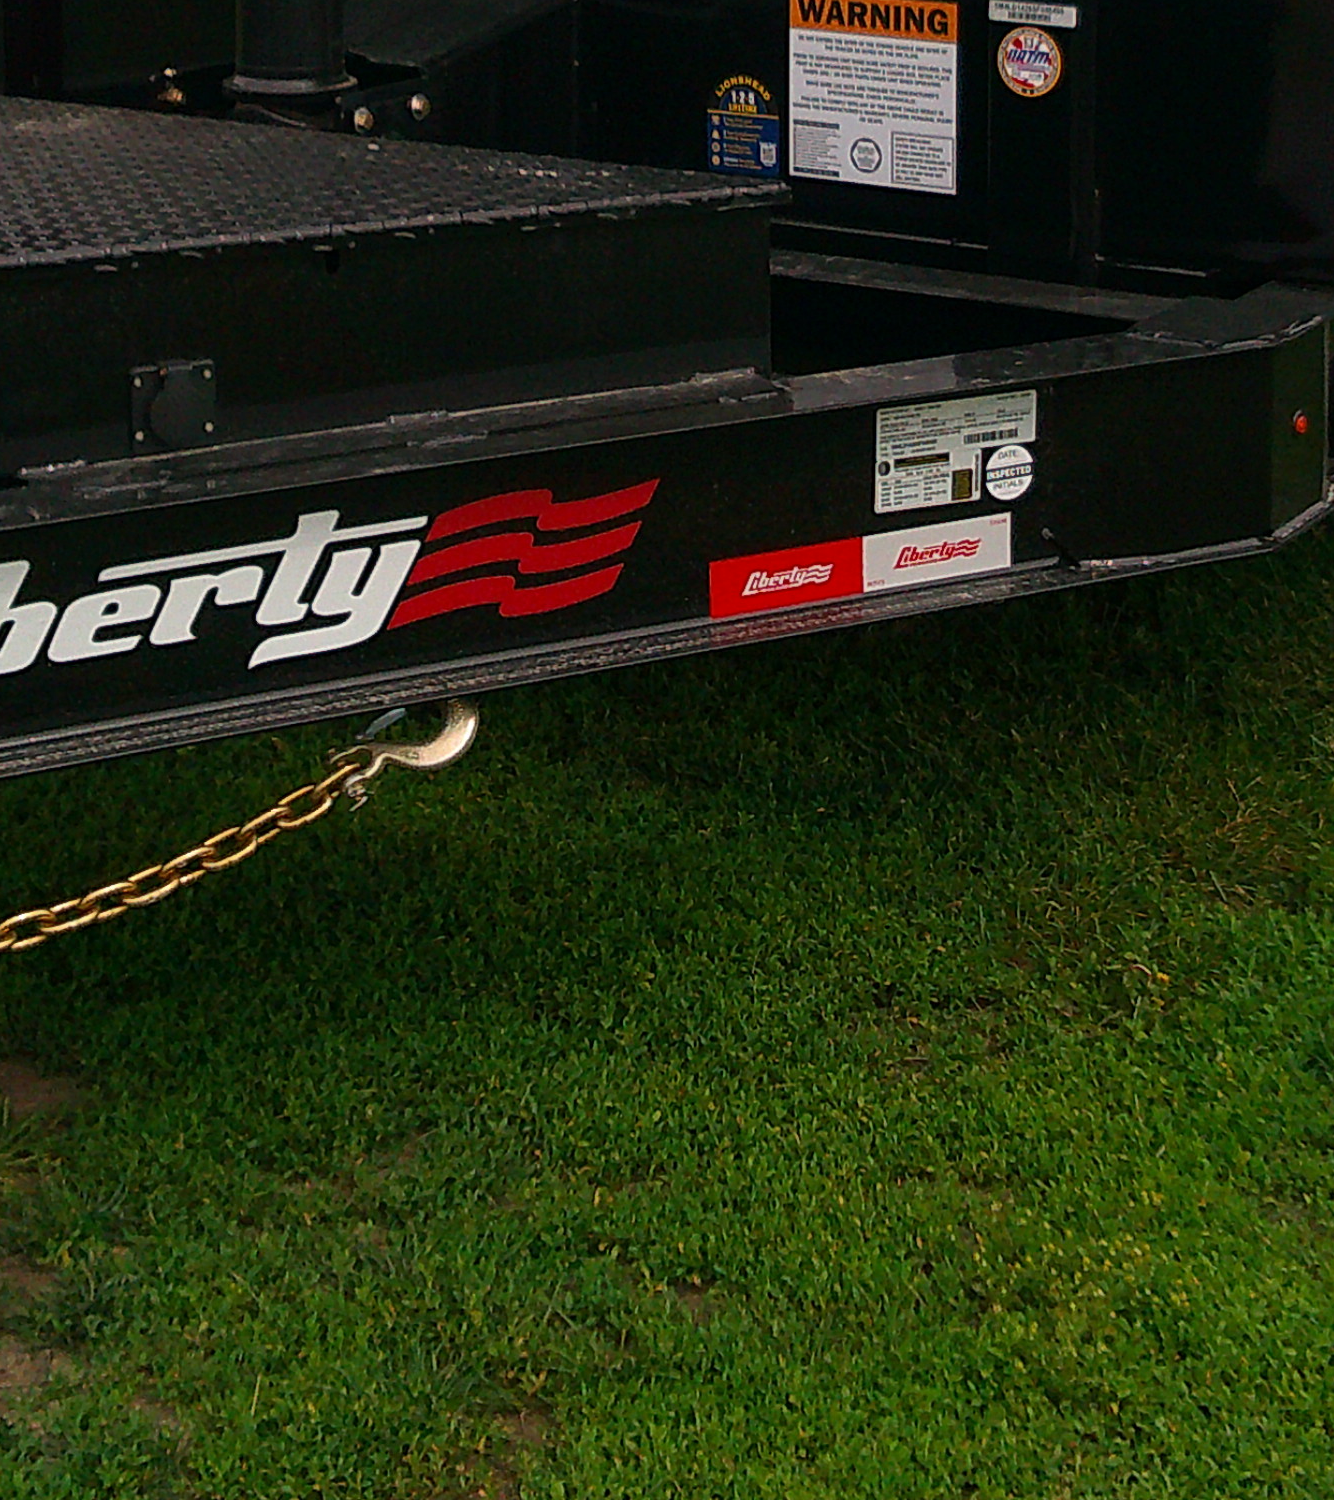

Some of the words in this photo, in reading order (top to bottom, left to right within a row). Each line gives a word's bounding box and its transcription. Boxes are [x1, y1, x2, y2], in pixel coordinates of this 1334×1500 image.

[986, 464, 1032, 481] INSPECTED
[893, 541, 956, 570] Liberty
[742, 566, 808, 596] Liberty
